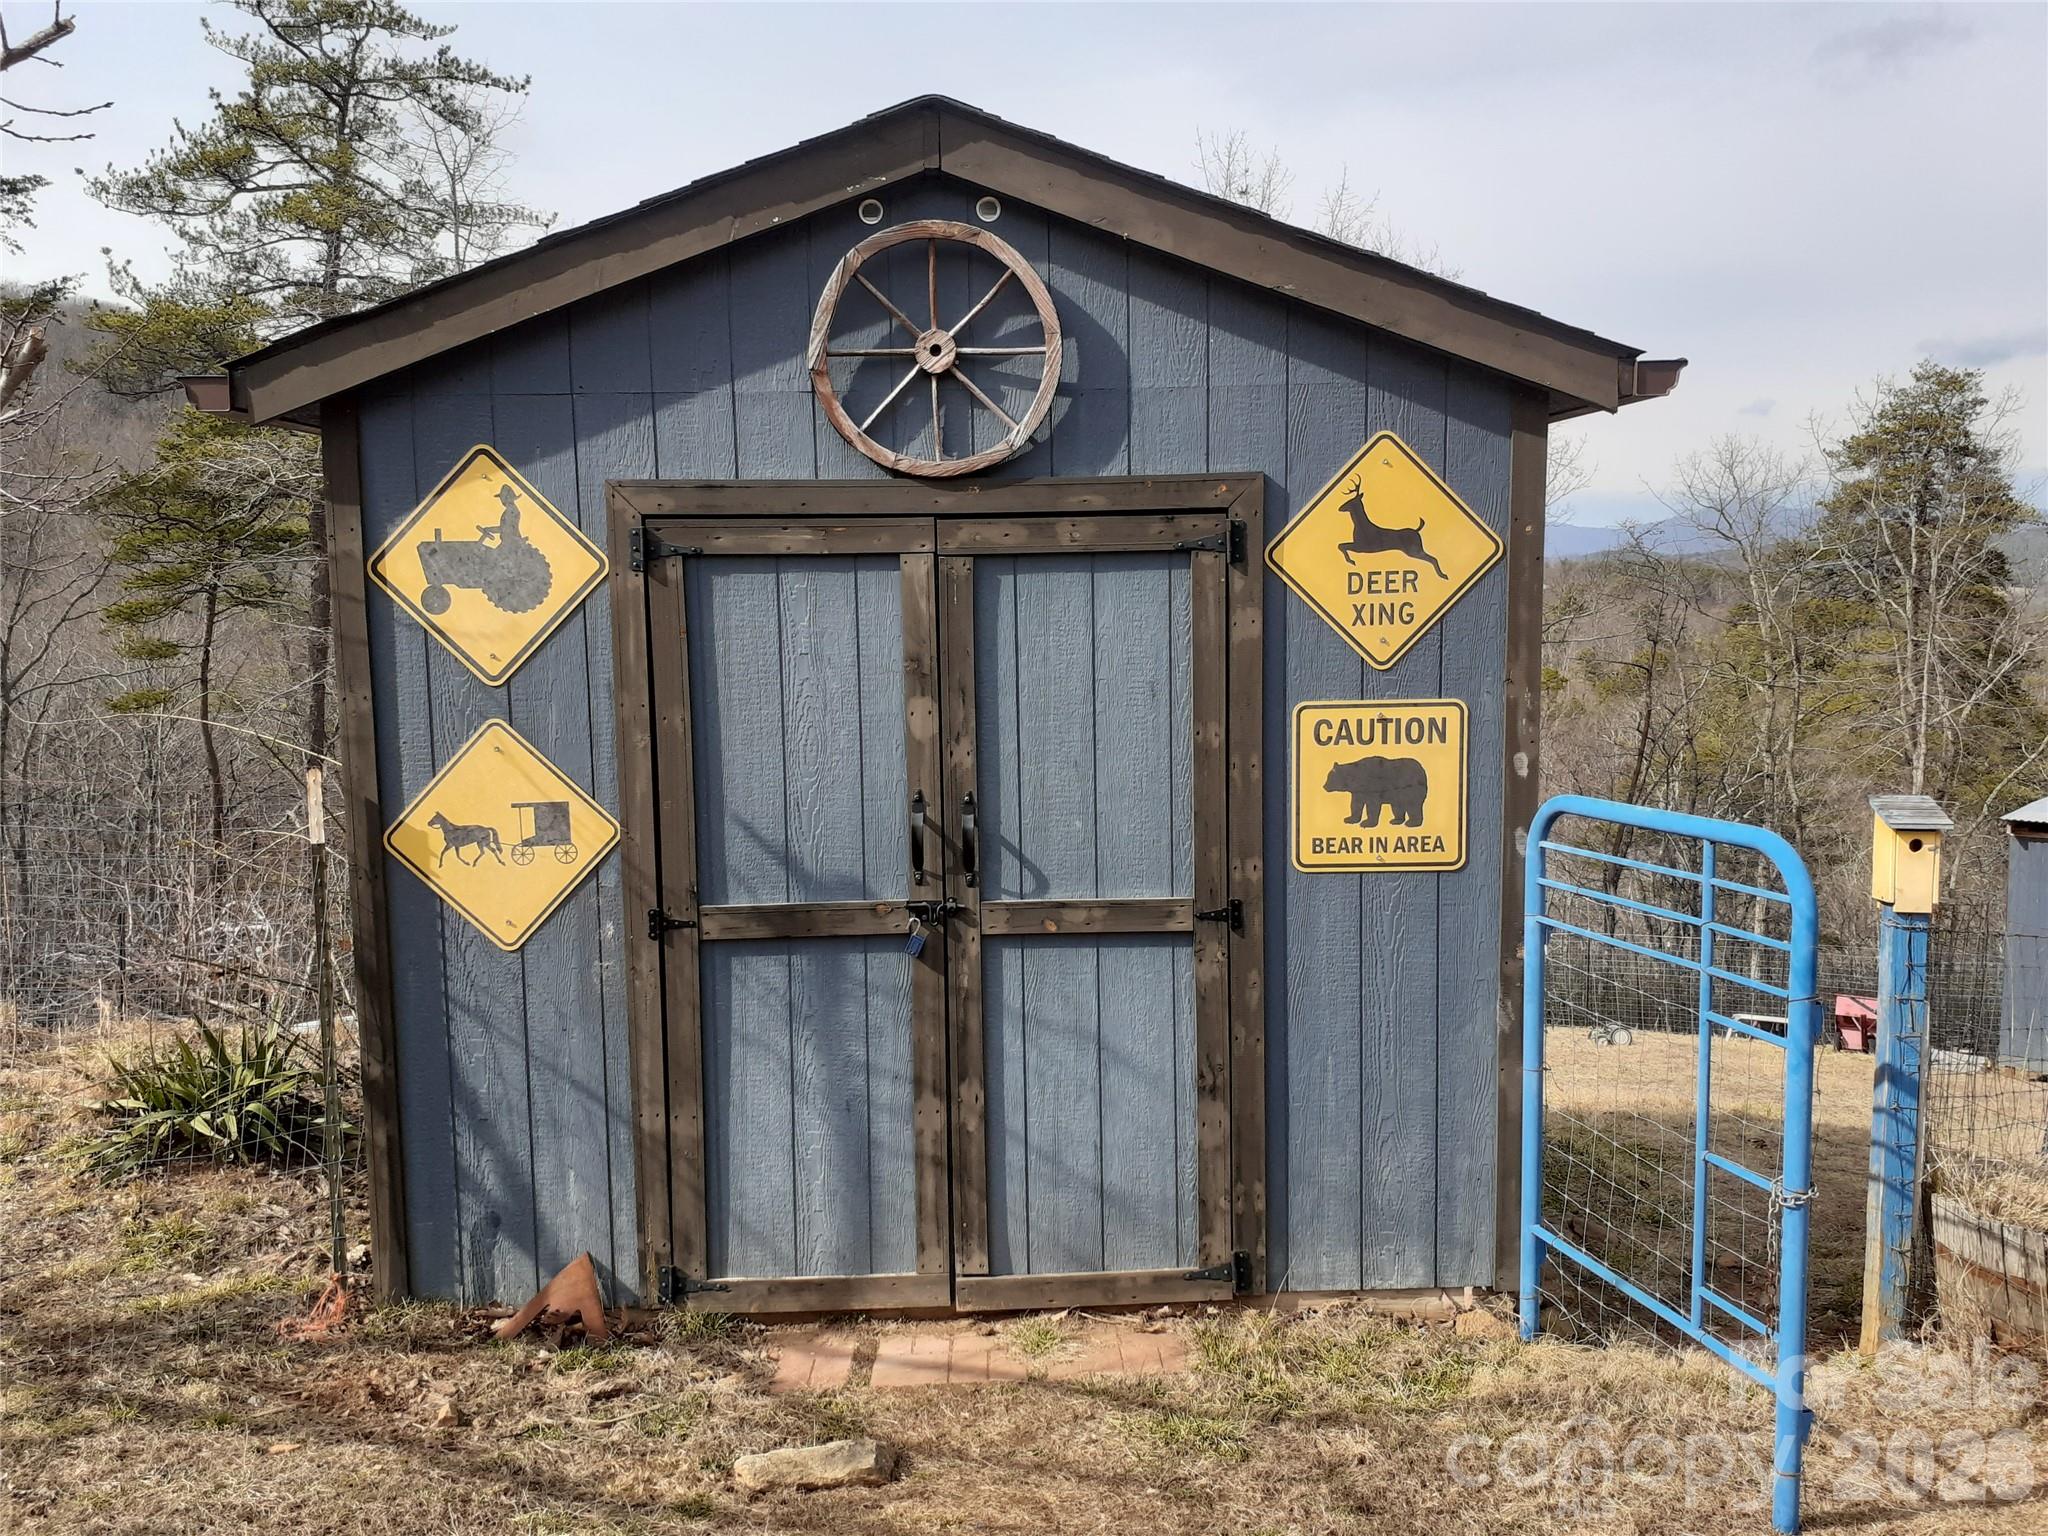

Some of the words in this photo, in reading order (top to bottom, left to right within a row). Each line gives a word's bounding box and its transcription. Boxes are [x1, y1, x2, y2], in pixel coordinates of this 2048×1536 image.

[1347, 570, 1418, 595] DEER
[1351, 602, 1415, 627] XING
[1313, 717, 1447, 746] CAUTION
[1311, 836, 1363, 854] BEAR
[1369, 836, 1388, 853] IN
[1393, 835, 1446, 853] AREA
